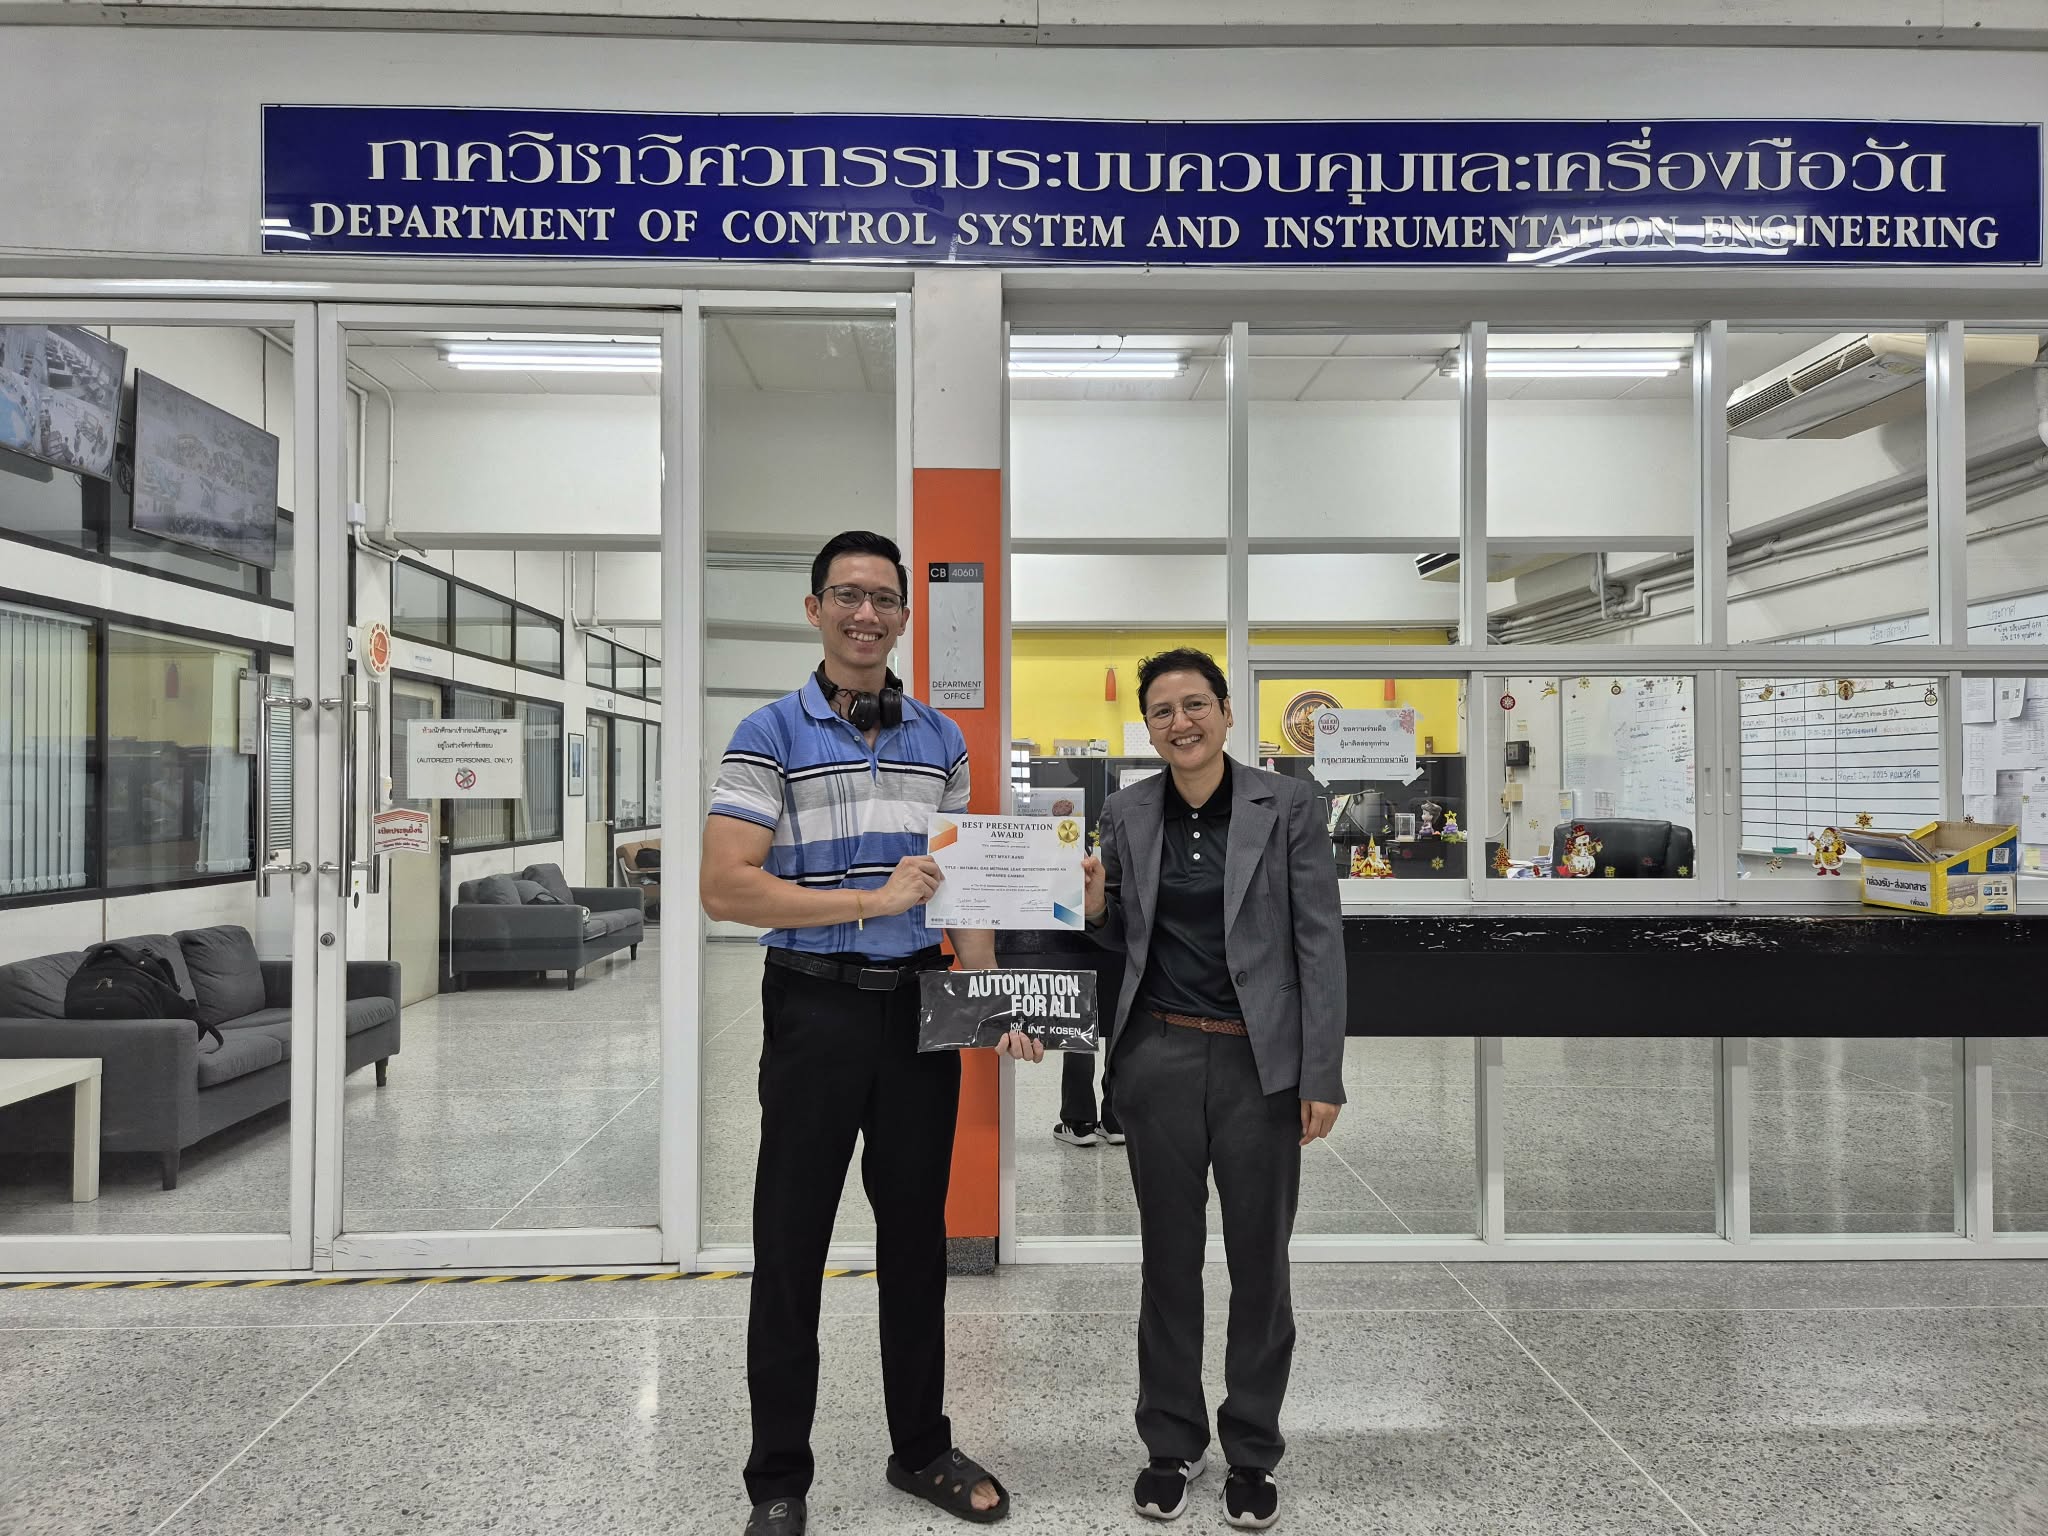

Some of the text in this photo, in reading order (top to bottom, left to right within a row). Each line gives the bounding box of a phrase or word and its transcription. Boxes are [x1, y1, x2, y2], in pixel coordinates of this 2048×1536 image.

[367, 126, 1947, 205] ภาควิชาวิศวกรรมระบบควบคุมและเครื่องมือวัด
[310, 202, 2000, 250] DEPARTMENT OF CONTROL SYSTEM AND INSTRUMENTATION ENGINEERING
[930, 568, 979, 578] CB 40601
[932, 680, 982, 689] DEPARTMENT
[962, 821, 1053, 831] BEST PRESENTATION
[990, 831, 1025, 839] AWARD
[1866, 876, 1927, 892] กล่องรับ-ส่งเอกสาร
[968, 974, 1081, 998] AUTOMATION
[1011, 994, 1081, 1019] FOR ALL
[1049, 1026, 1081, 1036] KOSEN
